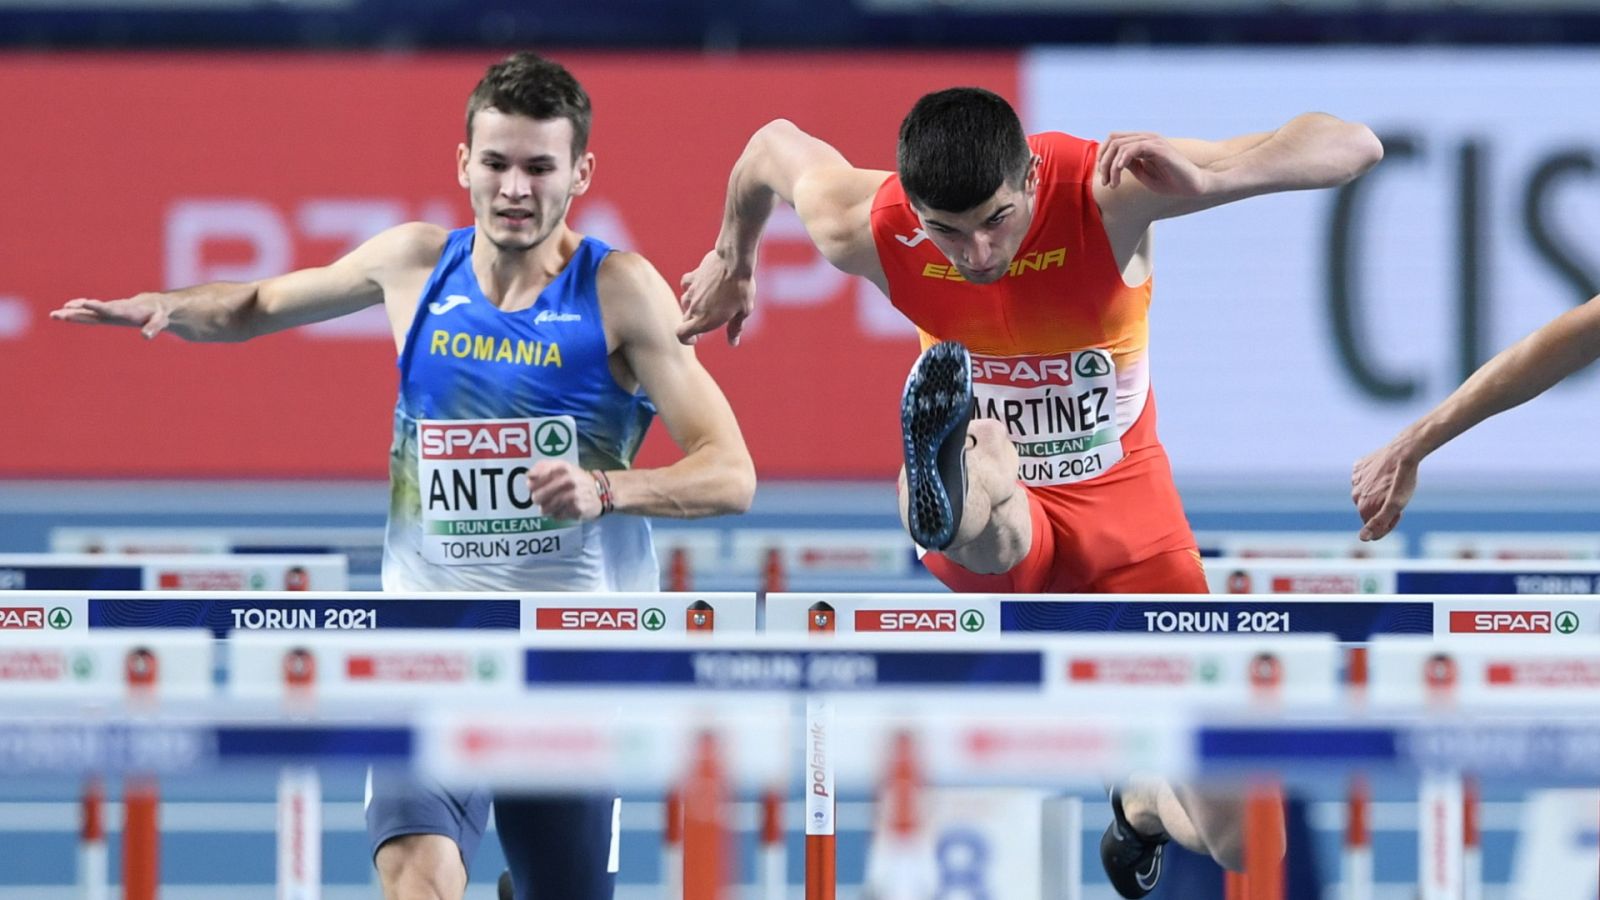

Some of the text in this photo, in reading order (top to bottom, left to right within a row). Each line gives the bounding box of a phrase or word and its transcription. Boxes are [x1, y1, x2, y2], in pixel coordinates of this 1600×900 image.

[922, 247, 1066, 282] ESAÑA
[430, 329, 563, 368] ROMANIA
[422, 427, 529, 456] SPAR
[1058, 453, 1103, 478] 2021
[429, 466, 535, 511] ANTO
[449, 522, 454, 534] I
[456, 521, 488, 534] RUN
[442, 535, 561, 560] TORUŃ 2021
[0, 610, 43, 627] AR
[231, 608, 377, 630] TORUN 2021
[561, 611, 636, 628] SPAR
[880, 612, 955, 630] SPAR
[1143, 611, 1290, 632] TORUN 2021
[1474, 614, 1550, 631] SPAR
